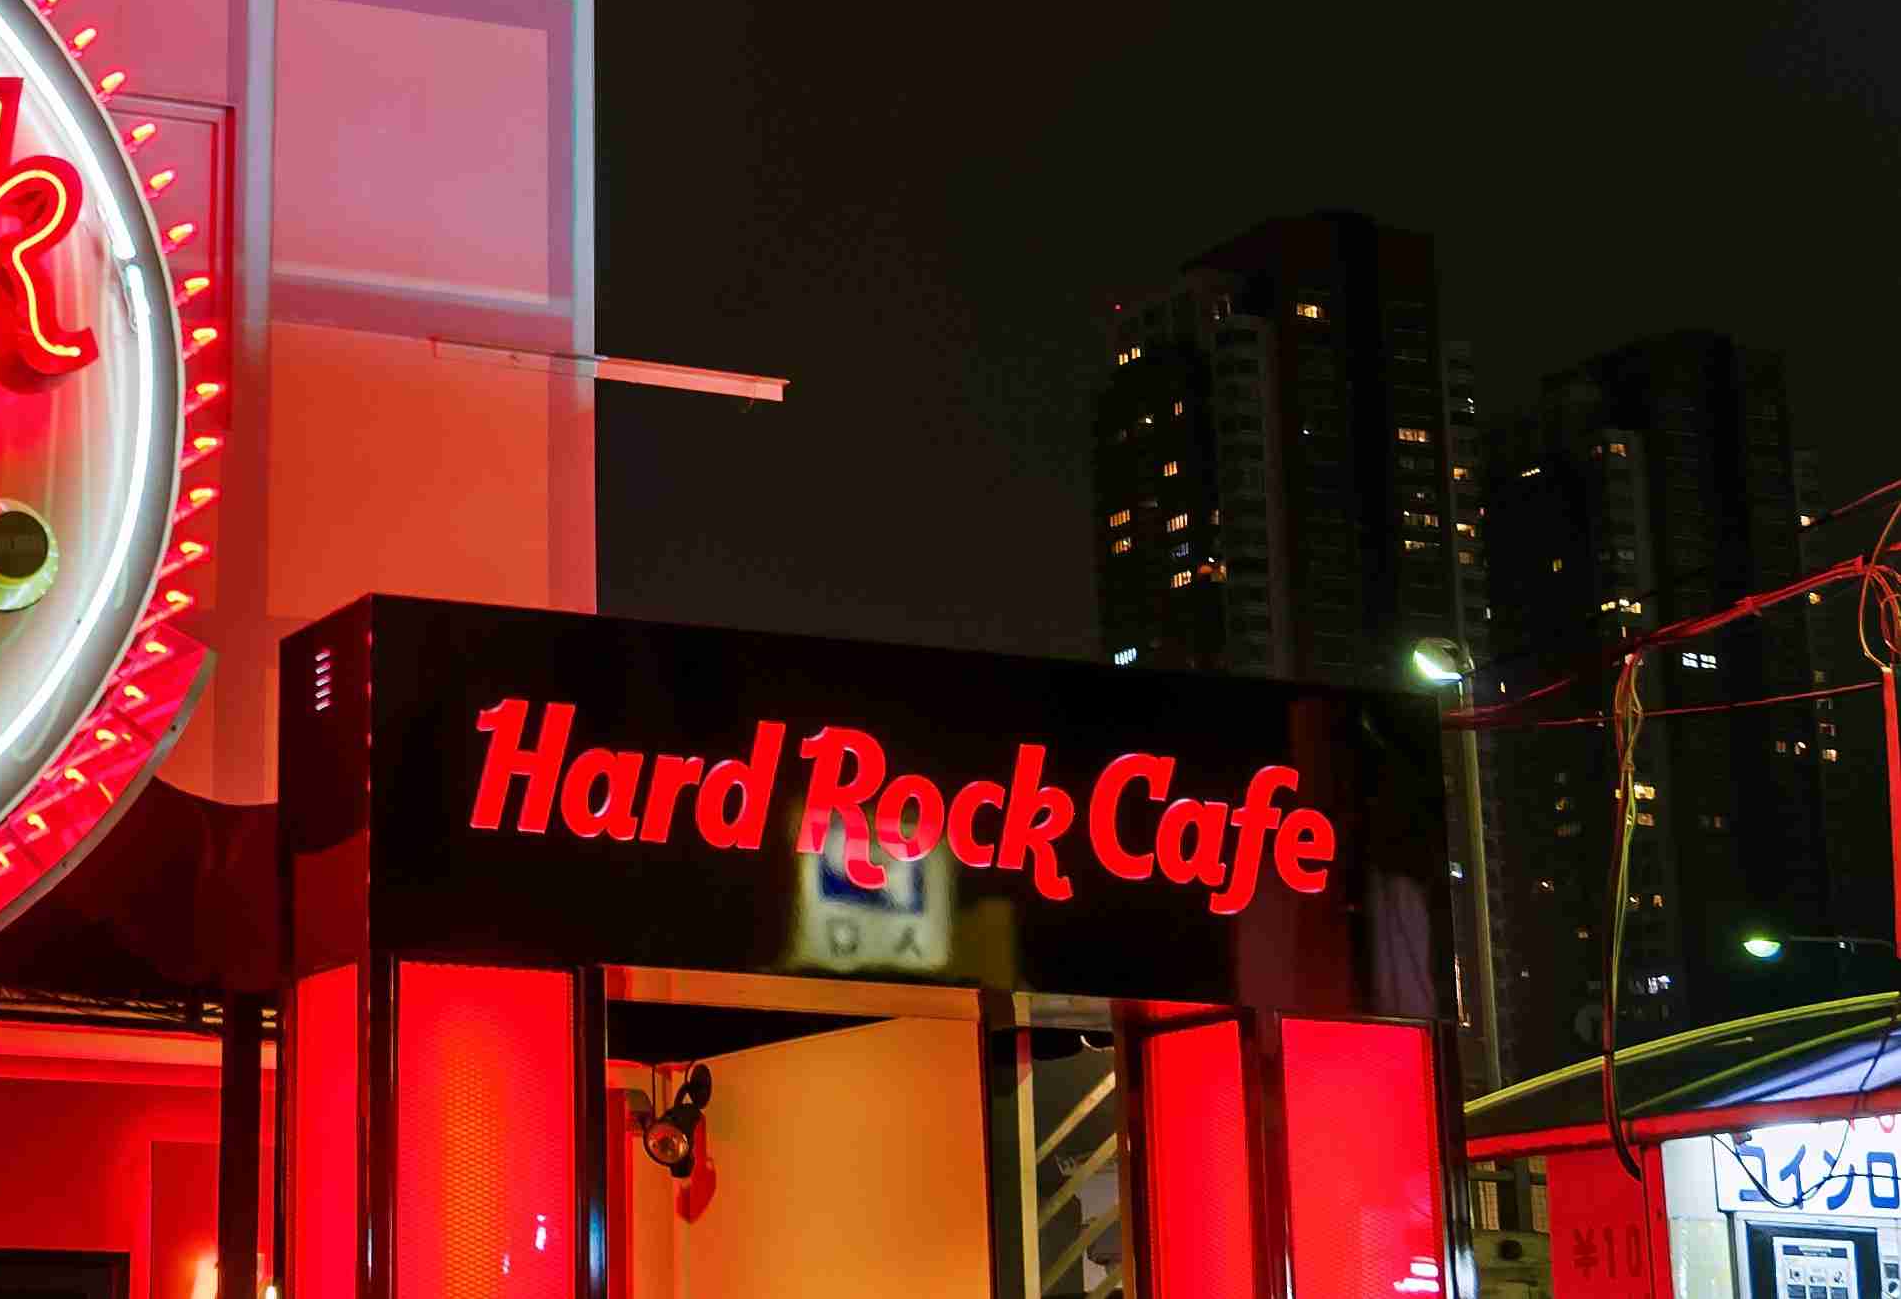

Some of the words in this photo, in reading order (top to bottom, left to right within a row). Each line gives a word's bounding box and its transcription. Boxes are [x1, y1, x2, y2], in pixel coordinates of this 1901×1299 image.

[470, 699, 786, 850] Hard
[796, 725, 1075, 900] Rock
[1089, 752, 1336, 915] Cafe
